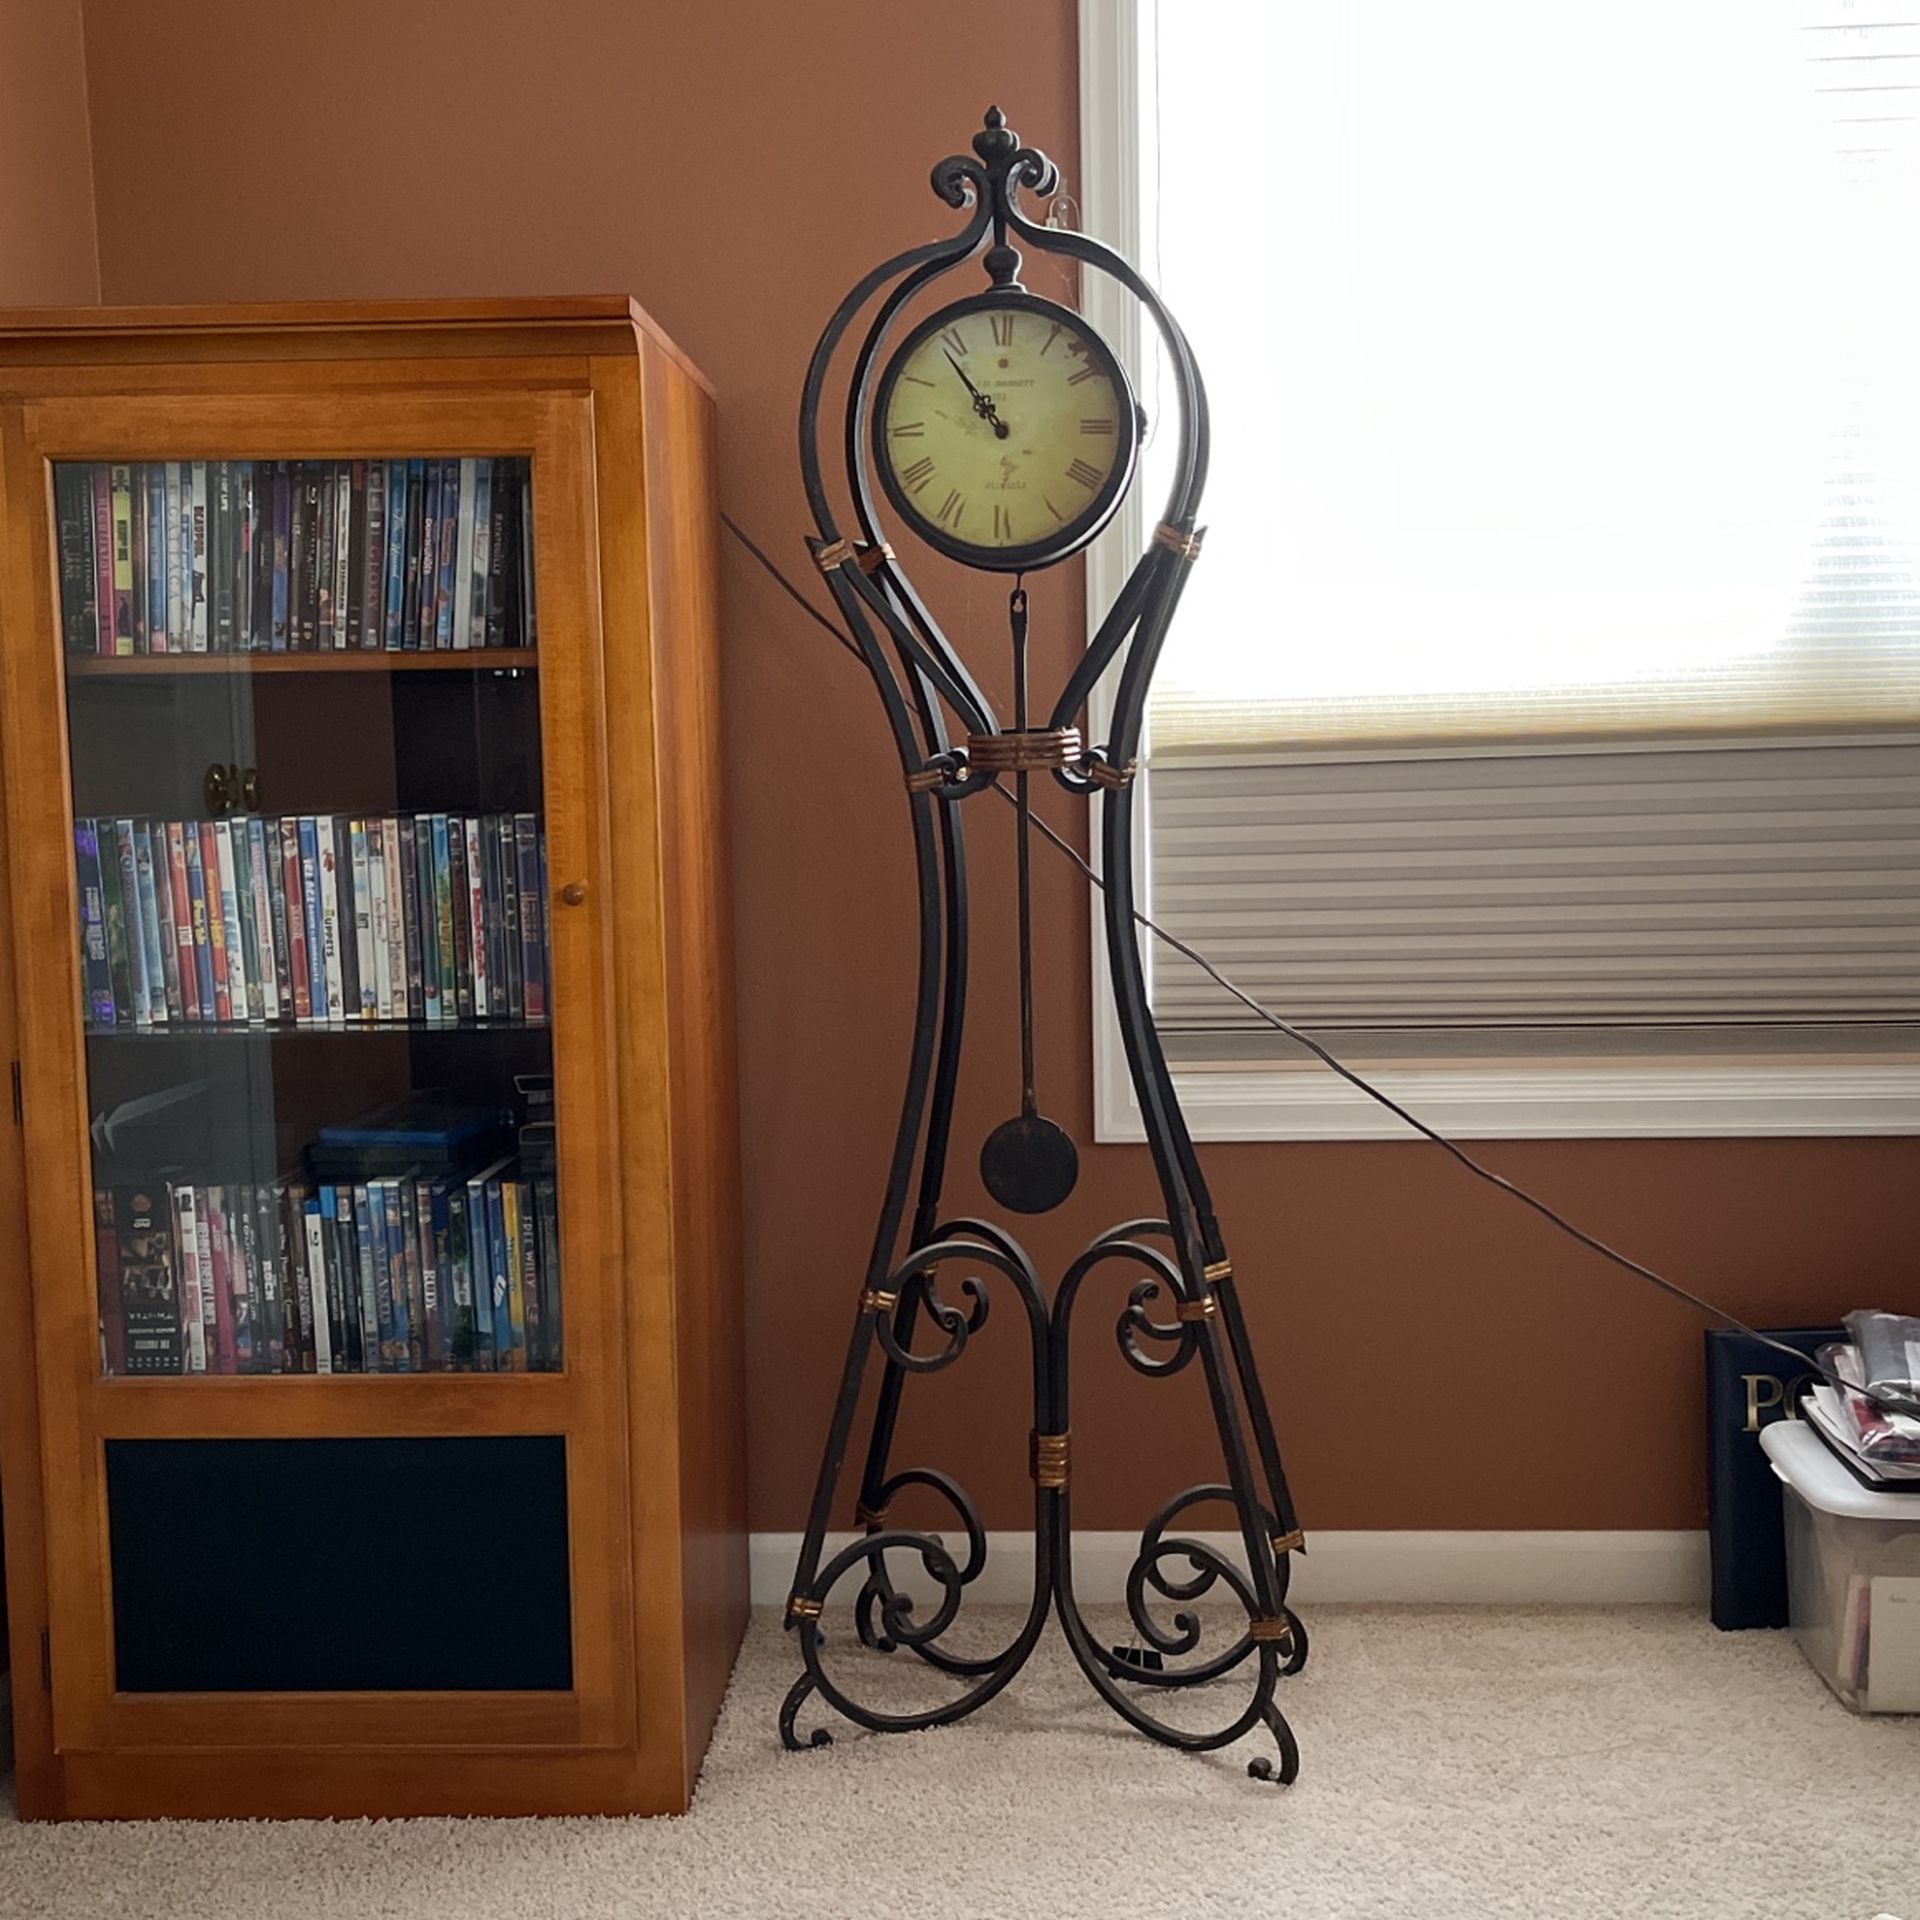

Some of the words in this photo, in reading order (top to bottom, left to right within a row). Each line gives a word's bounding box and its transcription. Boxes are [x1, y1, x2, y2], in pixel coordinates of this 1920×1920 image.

[194, 505, 205, 558] DEADPOOL
[63, 548, 75, 583] JANE
[368, 544, 379, 611] GLORY
[88, 924, 105, 960] NEMO
[197, 1222, 210, 1258] BEHIND
[521, 1214, 534, 1246] FREE
[200, 1260, 213, 1294] ENEMY
[262, 1259, 275, 1302] ROCK
[524, 1250, 536, 1288] WILLY
[423, 1269, 437, 1312] RUDY
[203, 1296, 216, 1325] LINES
